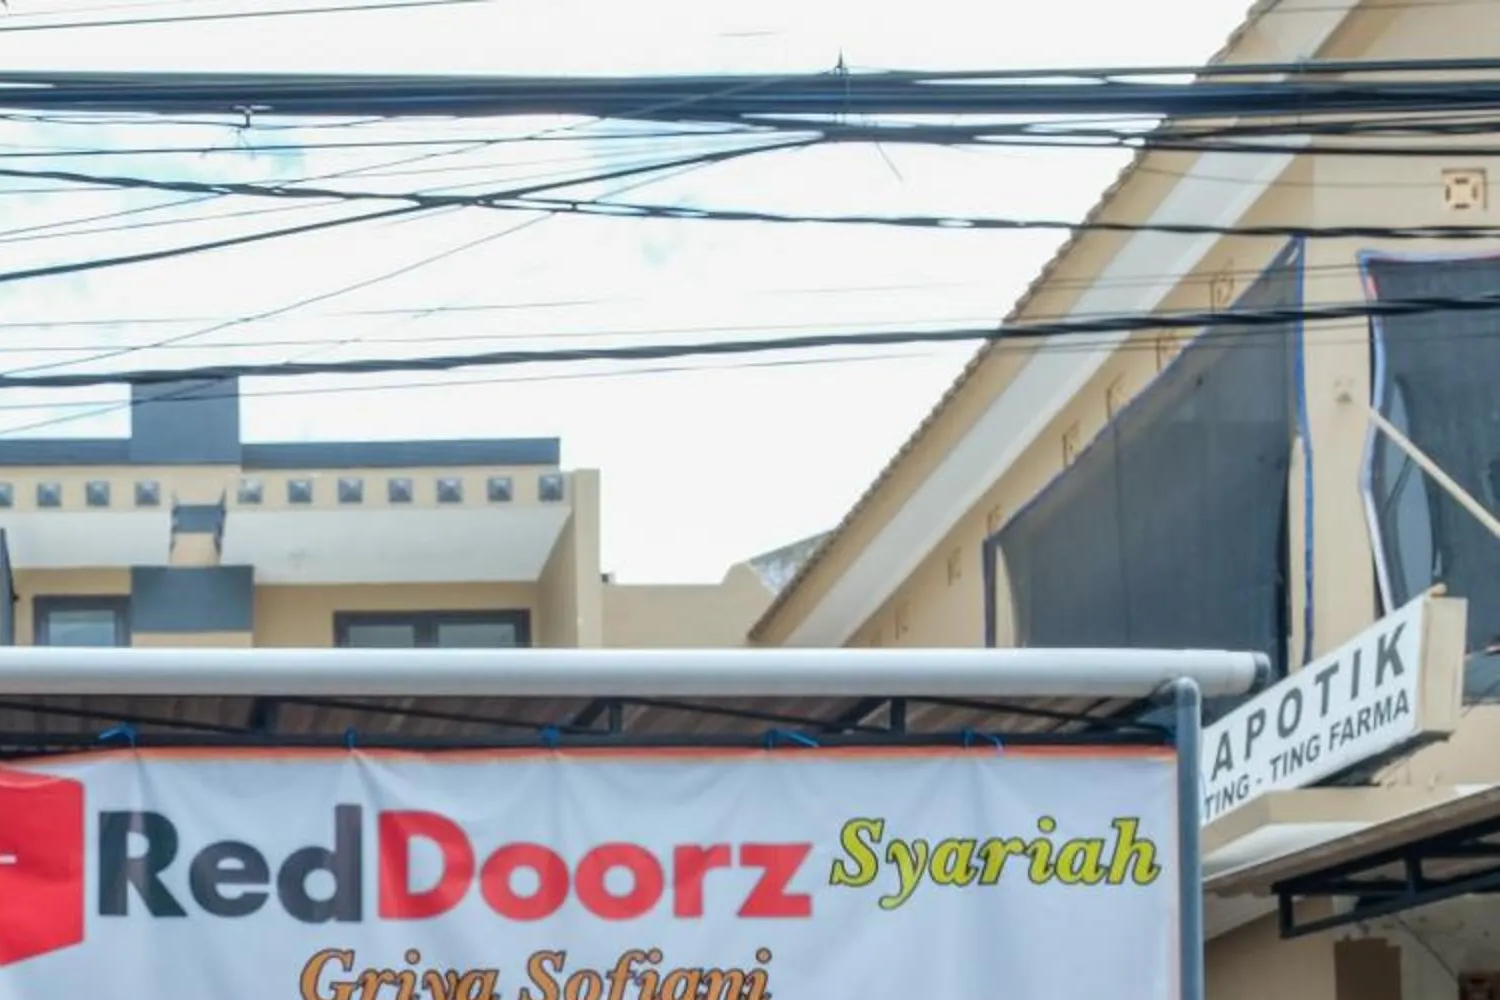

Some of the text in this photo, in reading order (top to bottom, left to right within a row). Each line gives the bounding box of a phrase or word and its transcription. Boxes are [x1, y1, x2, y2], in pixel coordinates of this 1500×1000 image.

[1203, 774, 1249, 819] TING
[1269, 734, 1321, 782] TING
[1328, 688, 1409, 751] FARMA
[1211, 621, 1407, 781] APOTIK
[98, 804, 1161, 923] RedDoorz Syariah
